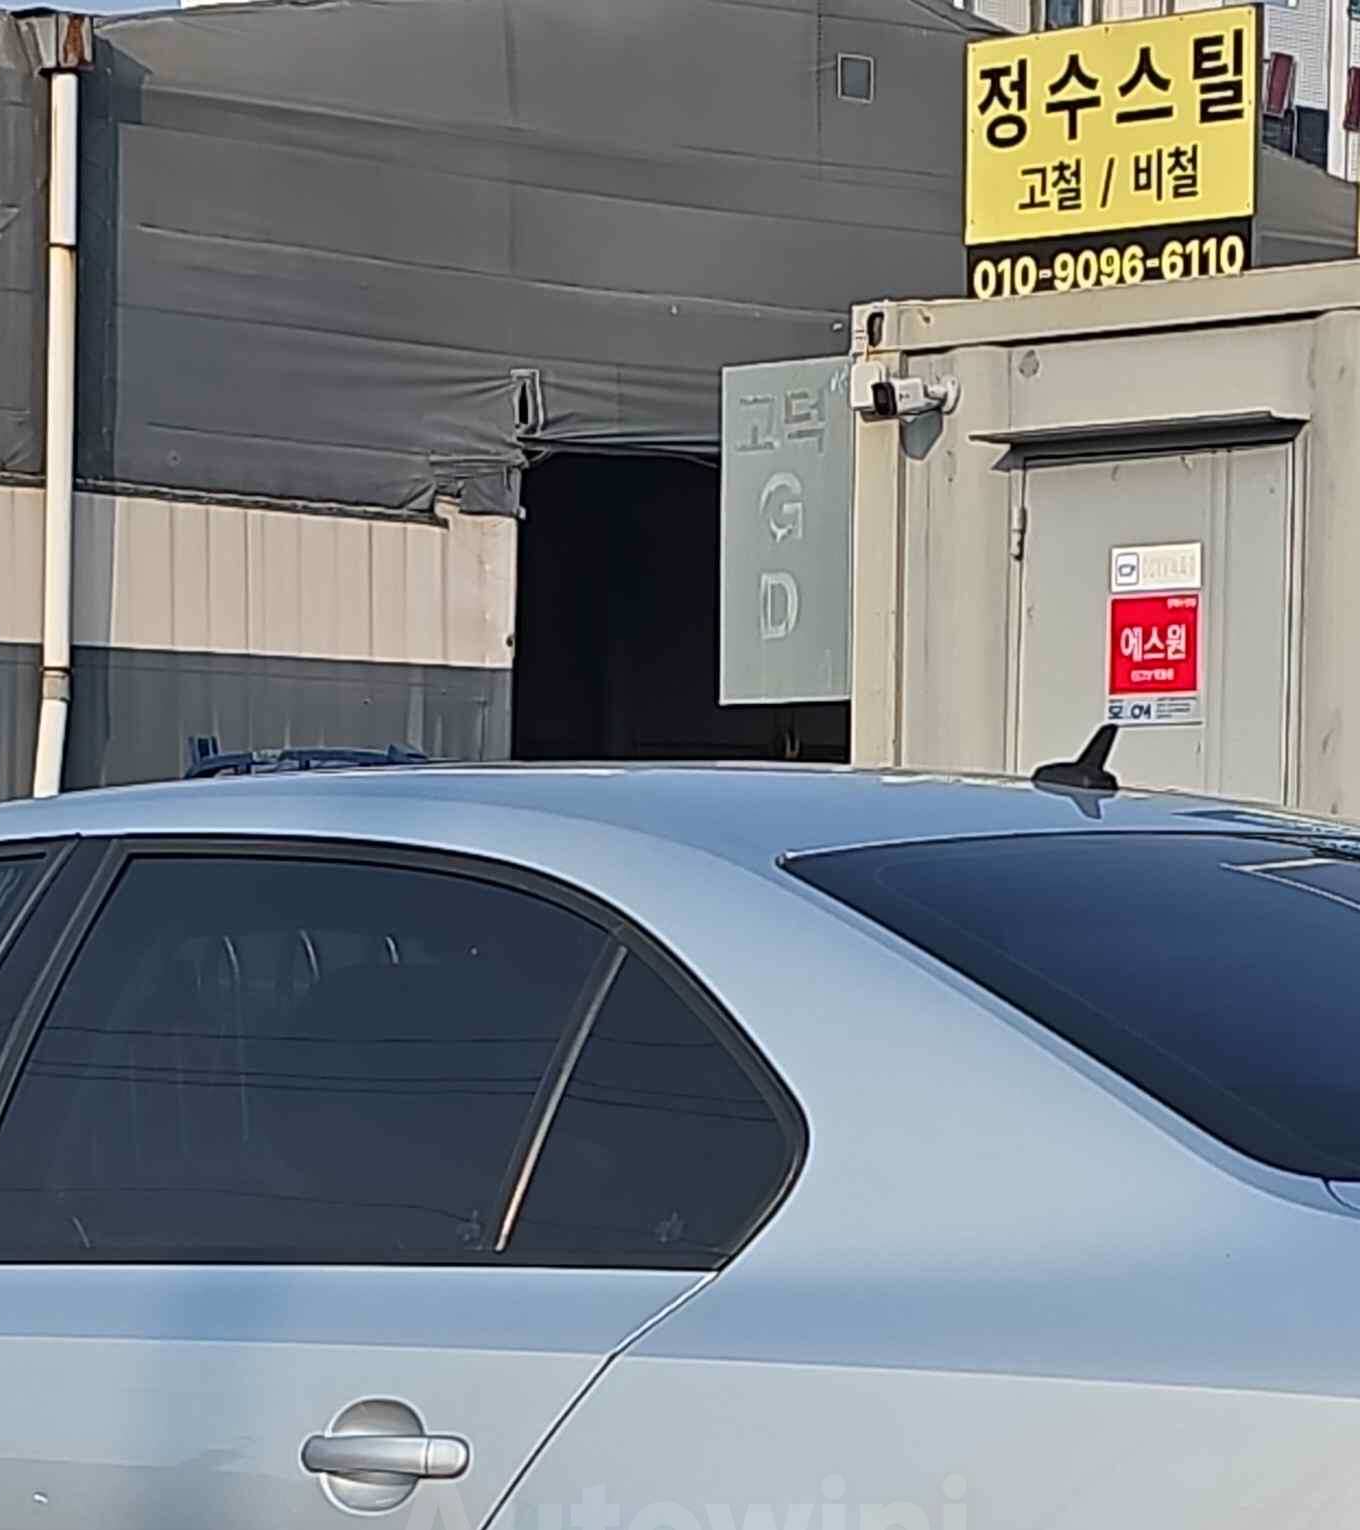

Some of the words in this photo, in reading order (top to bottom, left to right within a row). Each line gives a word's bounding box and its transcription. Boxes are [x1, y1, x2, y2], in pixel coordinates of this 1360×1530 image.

[977, 28, 1244, 149] 정수스틸
[1018, 157, 1083, 212] 고철
[1133, 143, 1199, 202] 비철
[973, 235, 1245, 299] 010-9096-6110
[1120, 623, 1187, 663] 에스원
